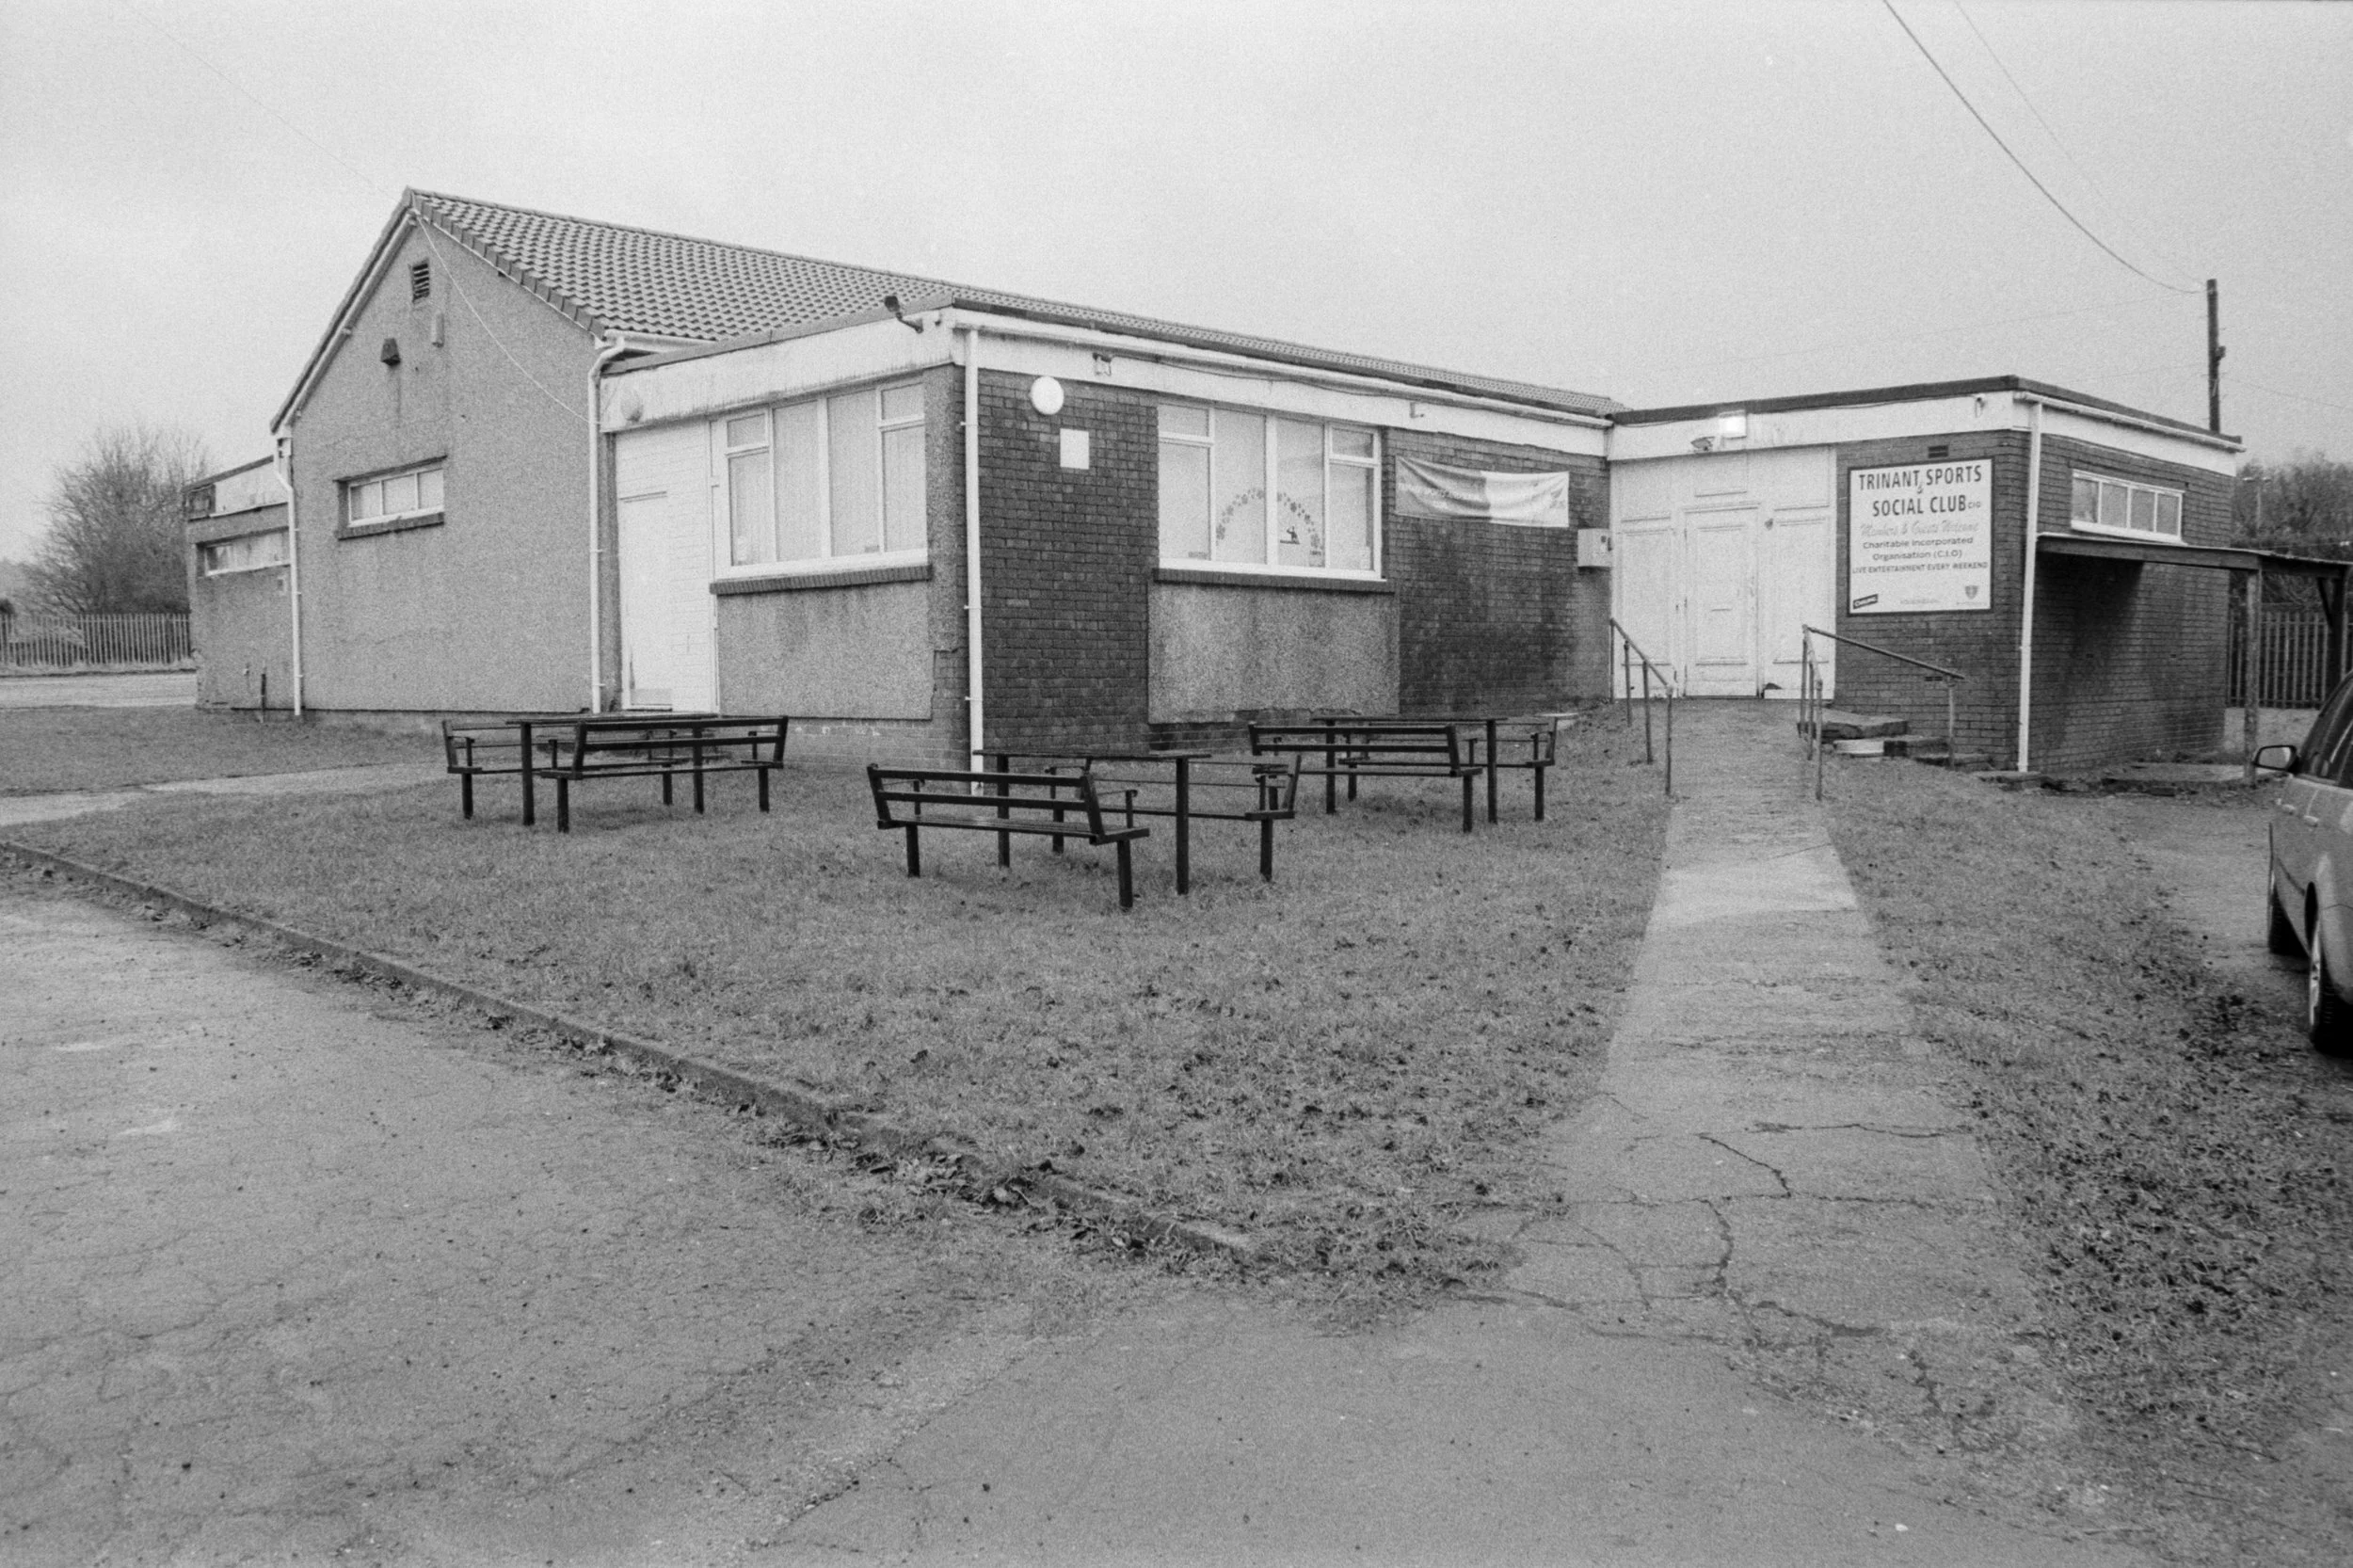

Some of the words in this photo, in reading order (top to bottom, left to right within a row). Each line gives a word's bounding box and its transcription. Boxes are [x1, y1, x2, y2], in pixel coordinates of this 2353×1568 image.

[1859, 470, 1921, 490] TRINANT
[1926, 465, 1982, 486] SPORTS
[1872, 498, 1924, 518] SOCIAL
[1929, 494, 1966, 514] CLUB
[1863, 539, 1909, 550] Charitable
[1872, 551, 1931, 562] Organisation
